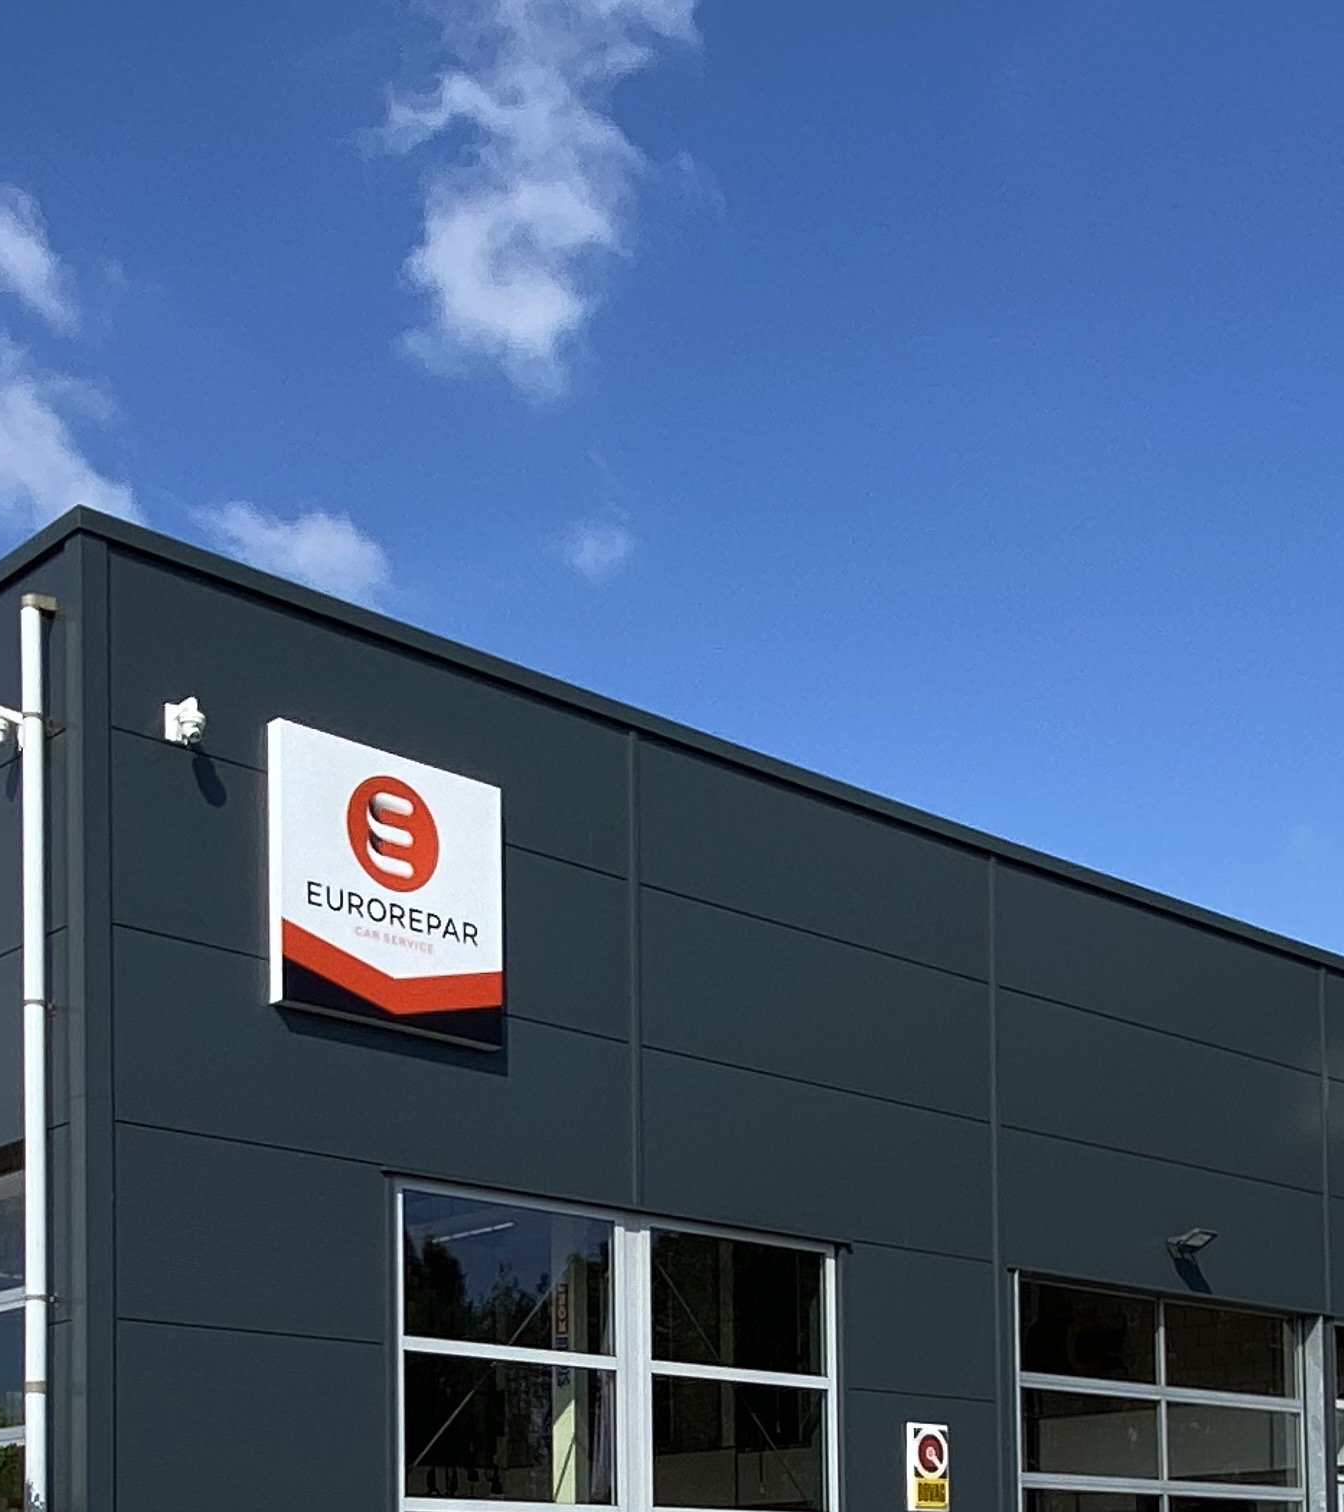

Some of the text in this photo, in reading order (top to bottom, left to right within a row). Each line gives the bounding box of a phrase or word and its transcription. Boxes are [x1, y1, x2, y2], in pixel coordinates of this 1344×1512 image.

[307, 880, 479, 947] EUROREPAR
[354, 926, 434, 954] CAR SERVICE
